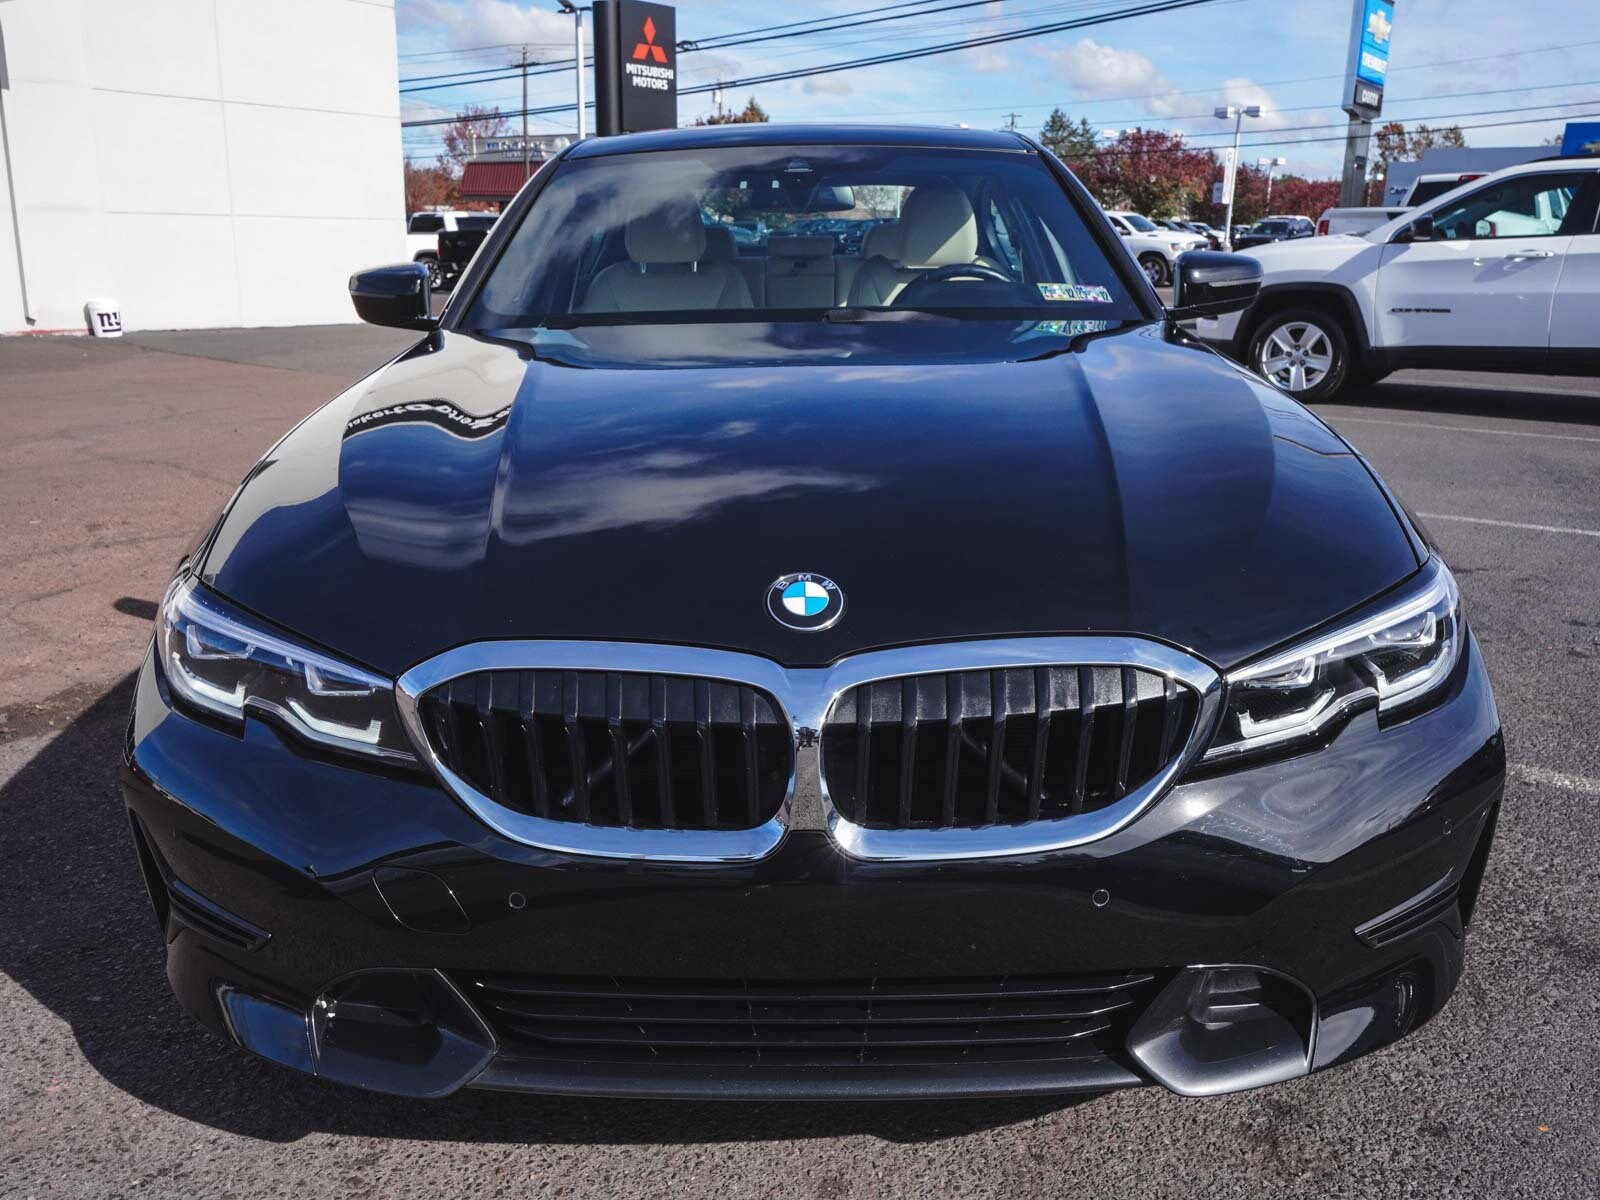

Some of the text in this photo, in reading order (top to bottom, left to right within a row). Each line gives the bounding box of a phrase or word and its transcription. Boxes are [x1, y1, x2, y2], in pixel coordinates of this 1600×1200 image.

[626, 62, 674, 80] MITSUBISHI
[632, 75, 669, 90] MOTORS
[775, 574, 836, 591] BMW
